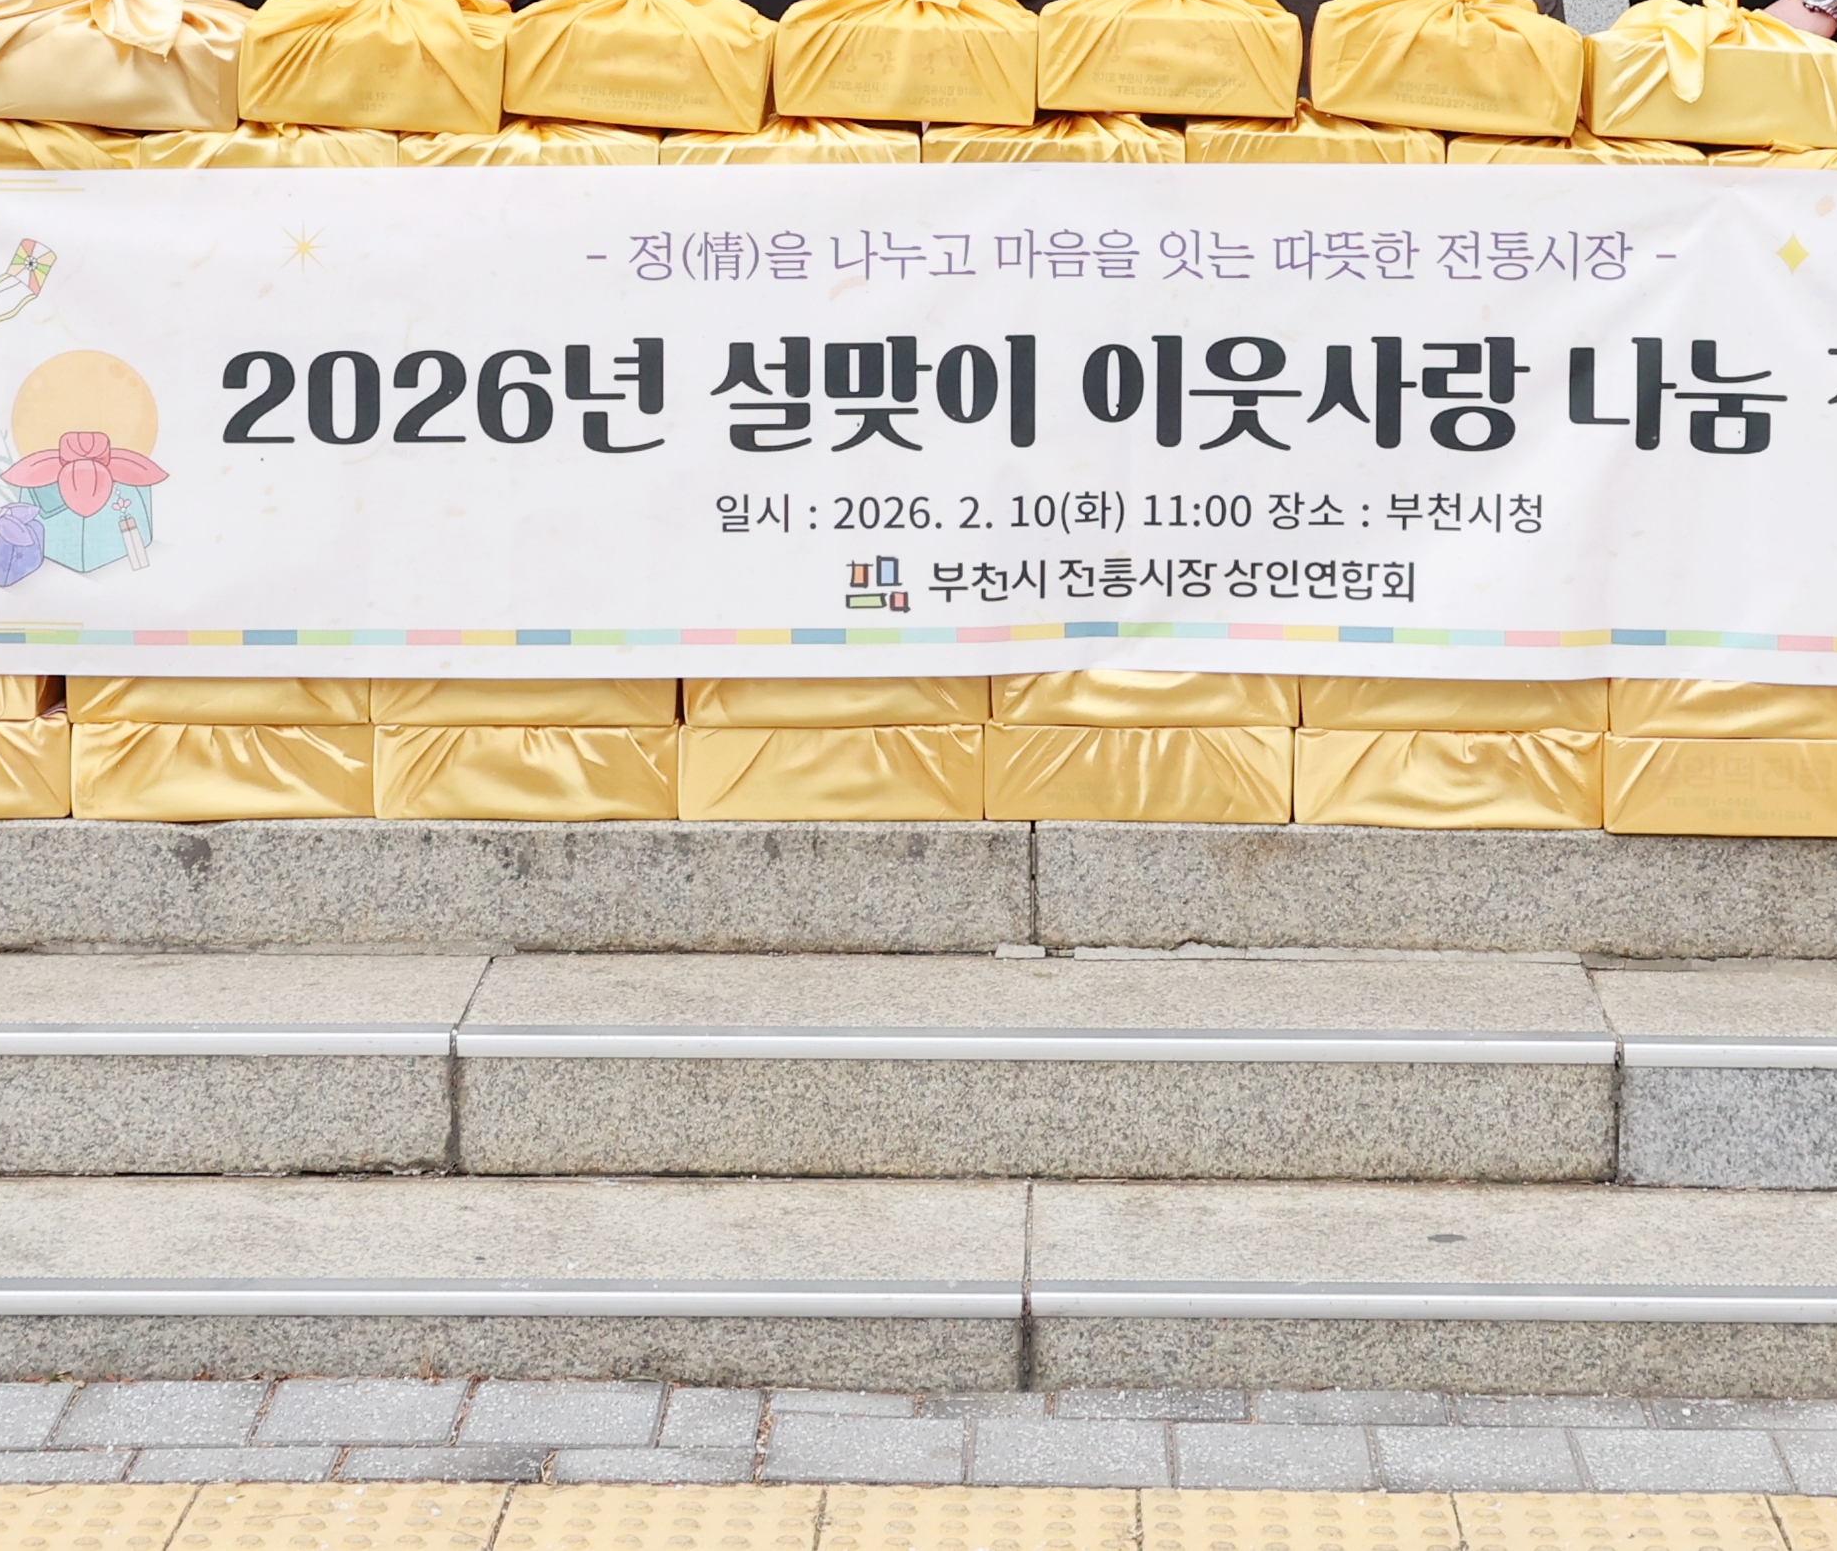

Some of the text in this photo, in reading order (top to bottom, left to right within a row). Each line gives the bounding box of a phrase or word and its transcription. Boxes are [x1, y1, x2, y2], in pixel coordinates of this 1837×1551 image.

[628, 230, 814, 282] 정(情)을
[830, 230, 978, 282] 나누고
[994, 229, 1141, 281] 마음을
[1160, 230, 1257, 281] 잇는
[1274, 230, 1421, 282] 따뜻한
[1437, 230, 1635, 282] 전통시장
[222, 336, 666, 455] 2026년
[710, 335, 1038, 453] 설맞이
[1082, 335, 1532, 453] 이웃사랑
[1568, 337, 1790, 456] 나눔
[715, 493, 791, 535] 일시
[834, 496, 943, 531] 2026.
[959, 496, 994, 531] 2.
[1010, 491, 1127, 536] 10(화)
[1143, 494, 1253, 530] 11:00
[1268, 492, 1346, 532] 장소
[1385, 493, 1544, 535] 부천시청
[928, 560, 1047, 604] 부천시
